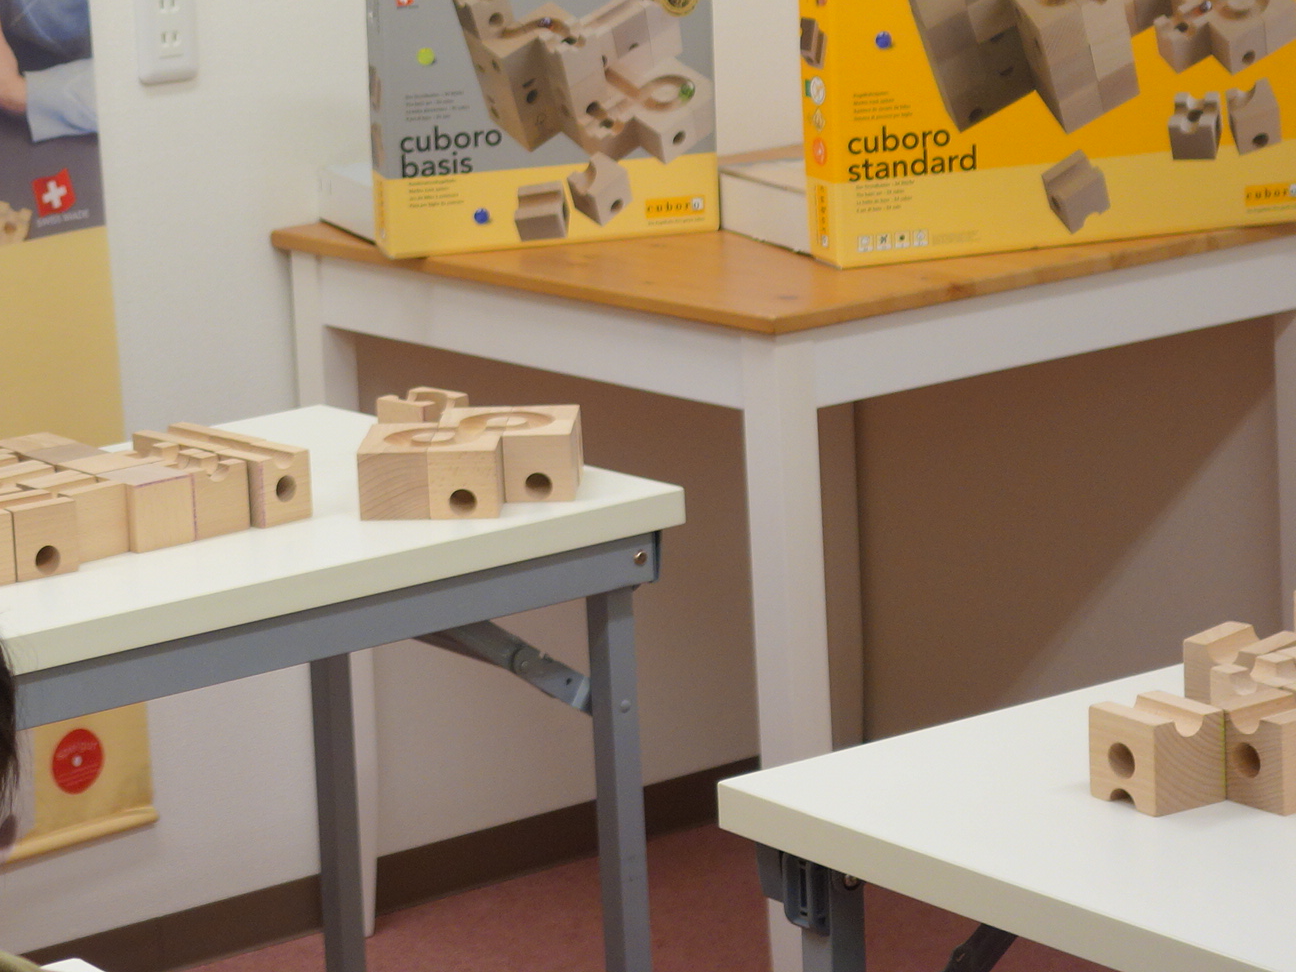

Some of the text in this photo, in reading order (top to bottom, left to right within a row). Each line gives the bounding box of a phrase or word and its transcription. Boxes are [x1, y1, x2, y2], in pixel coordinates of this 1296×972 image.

[400, 125, 502, 153] cuboro
[847, 125, 951, 155] cuboro
[401, 151, 473, 178] basis
[847, 144, 977, 182] standard
